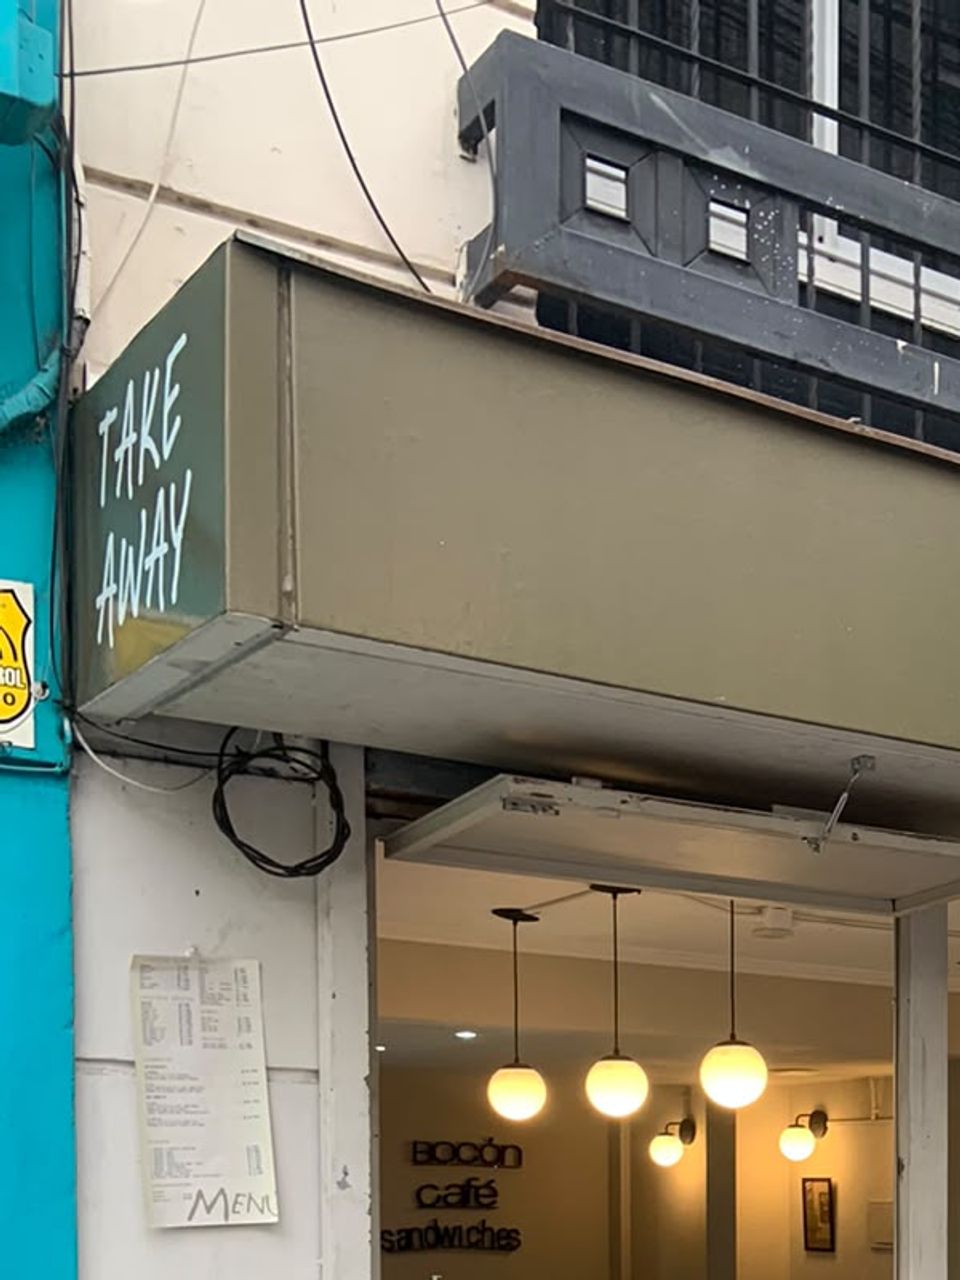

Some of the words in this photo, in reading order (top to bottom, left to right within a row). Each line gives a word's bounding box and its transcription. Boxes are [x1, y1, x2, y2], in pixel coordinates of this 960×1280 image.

[98, 333, 188, 508] TAKE
[95, 468, 193, 649] AWAY
[381, 1219, 522, 1254] sandwiches
